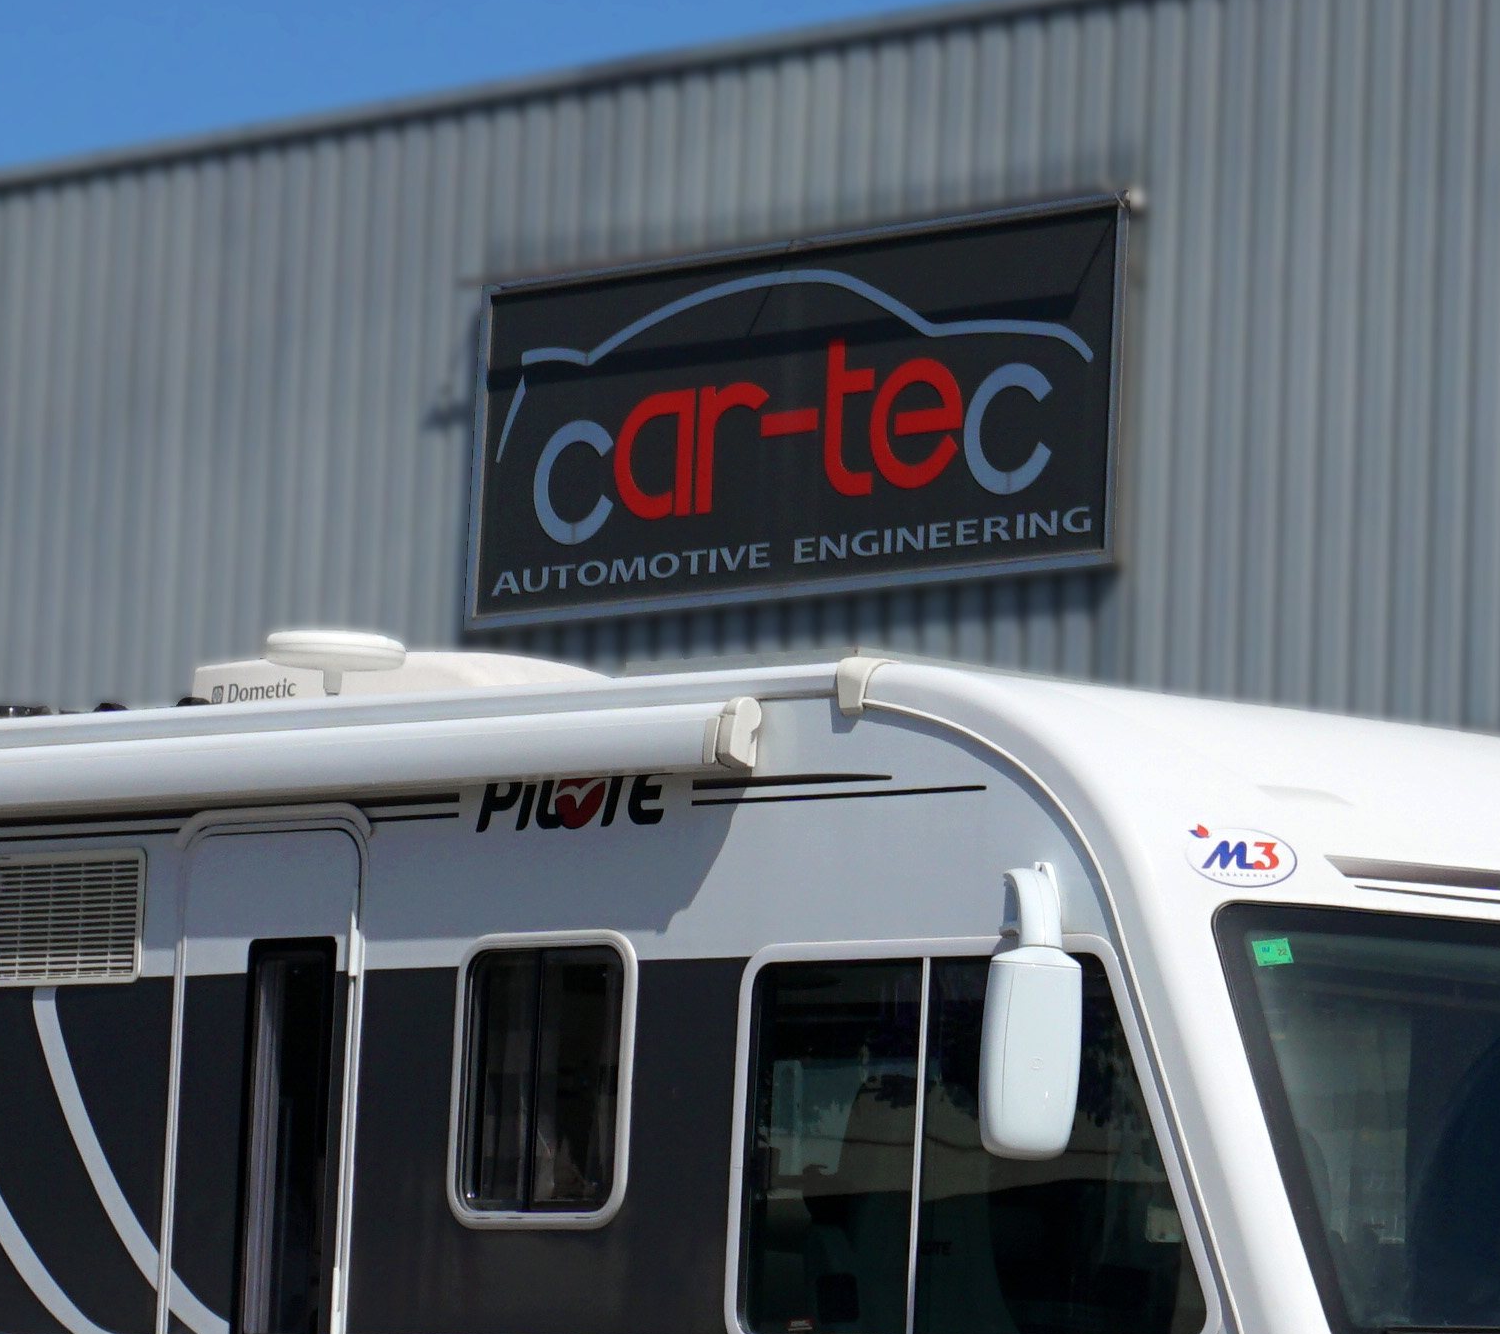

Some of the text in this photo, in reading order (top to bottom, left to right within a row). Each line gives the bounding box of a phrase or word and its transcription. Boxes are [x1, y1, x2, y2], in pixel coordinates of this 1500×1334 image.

[533, 339, 1053, 546] car-tec
[491, 505, 1093, 598] AUTOMOTIVE ENGINEERING
[227, 678, 297, 703] Dometic
